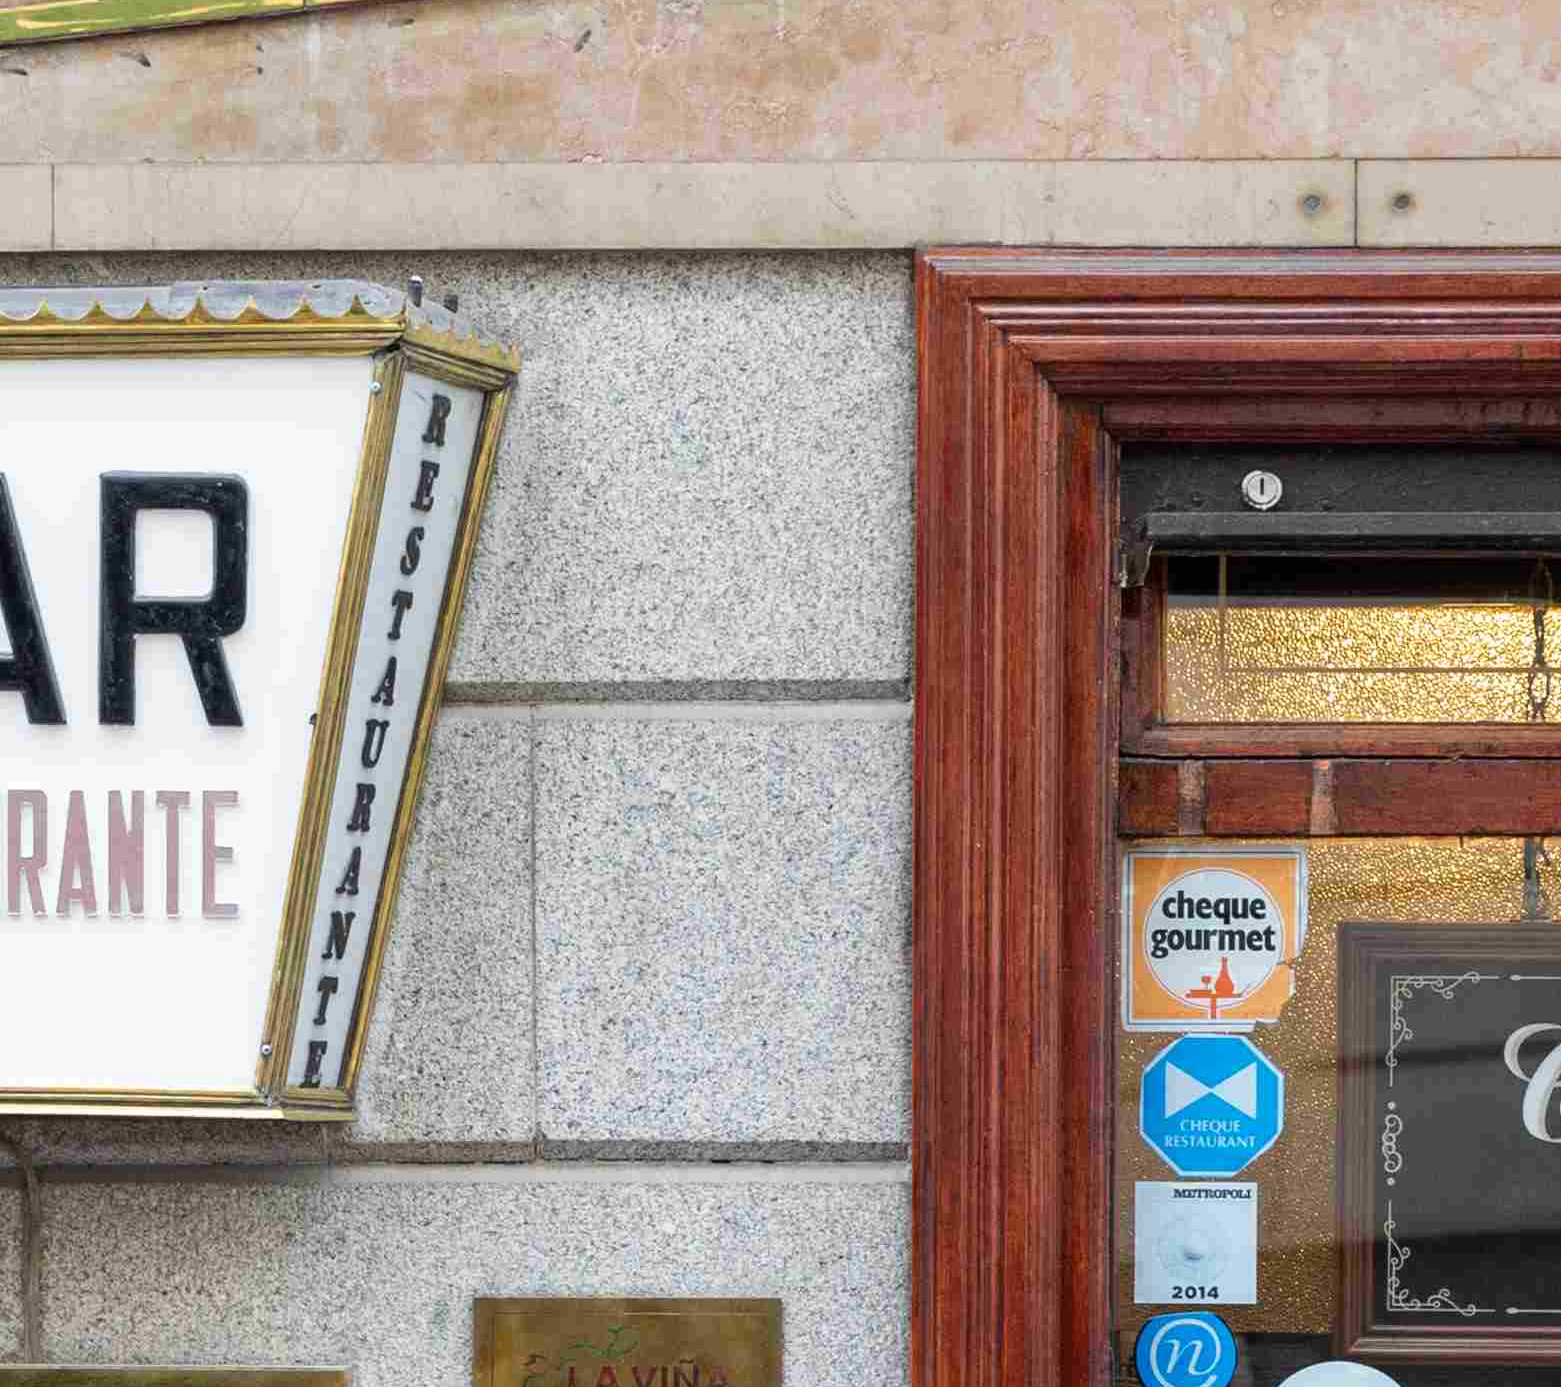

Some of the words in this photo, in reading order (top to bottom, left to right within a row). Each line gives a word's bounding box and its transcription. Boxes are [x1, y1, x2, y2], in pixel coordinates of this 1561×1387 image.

[299, 392, 453, 1090] RESTAURANTE
[1162, 890, 1267, 925] cheque
[1151, 925, 1276, 959] gourmet
[1180, 1119, 1241, 1133] CHEQUE
[1165, 1135, 1257, 1149] RESTAURANT
[1172, 1188, 1252, 1199] METROPOLI
[1171, 1286, 1219, 1300] 2014
